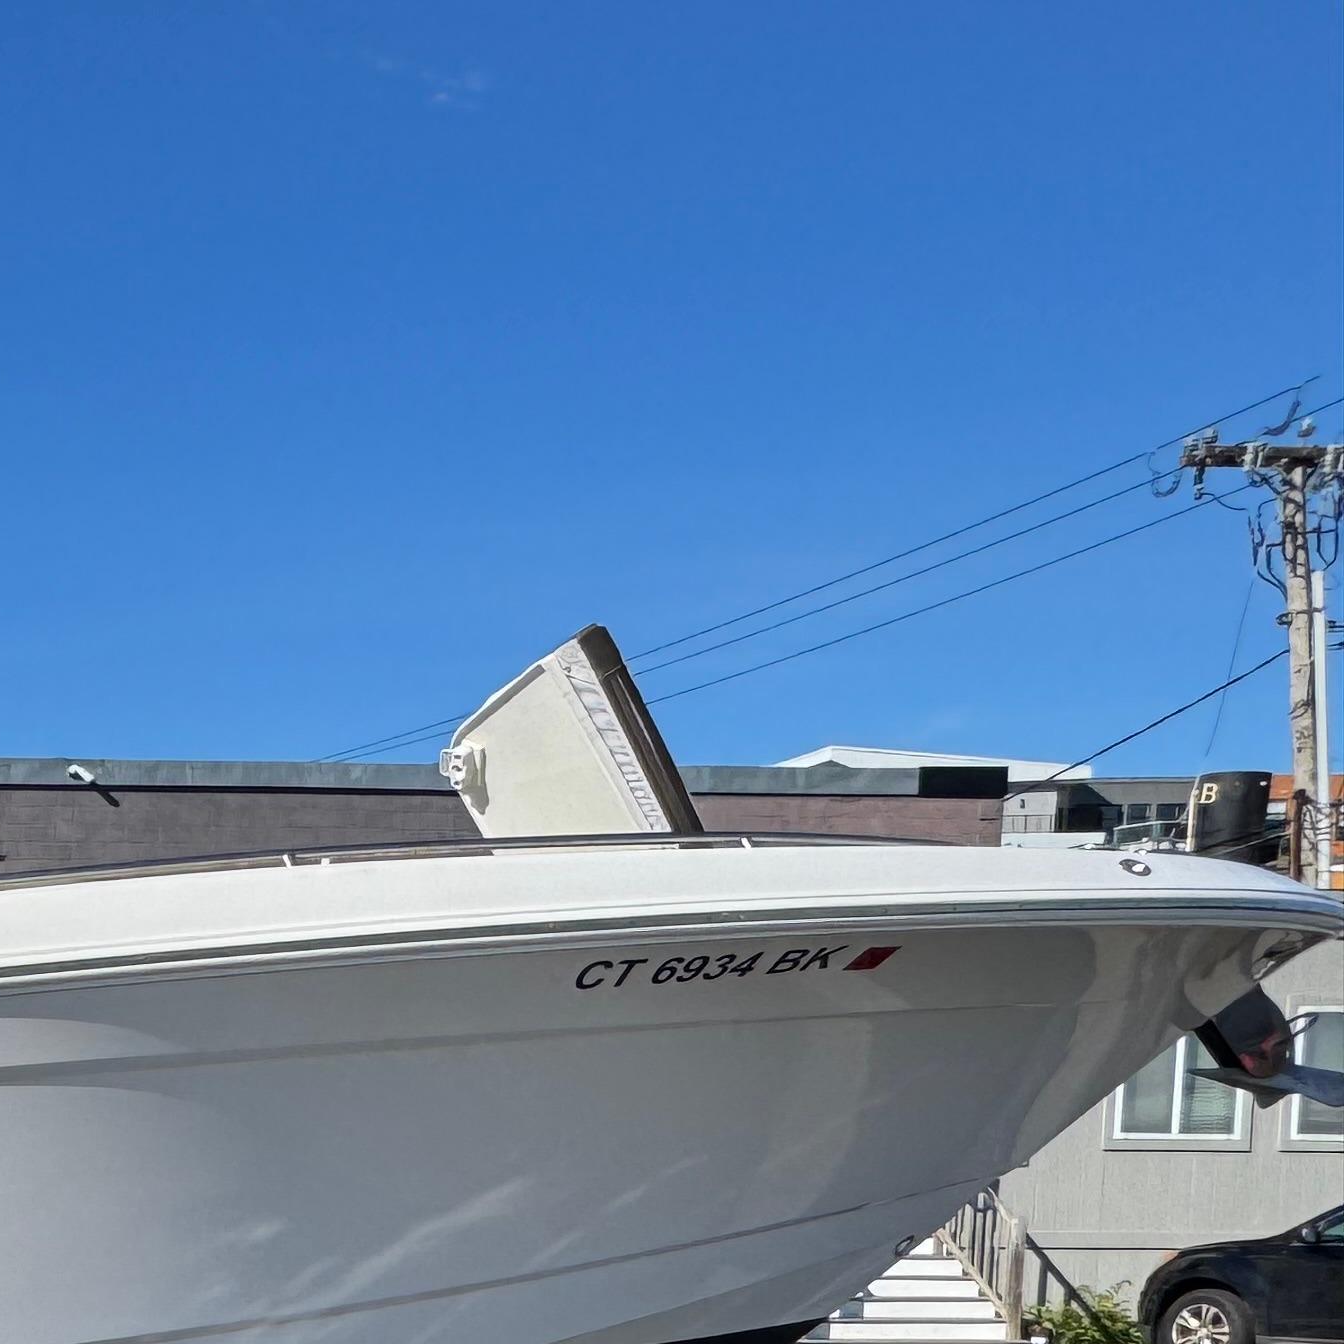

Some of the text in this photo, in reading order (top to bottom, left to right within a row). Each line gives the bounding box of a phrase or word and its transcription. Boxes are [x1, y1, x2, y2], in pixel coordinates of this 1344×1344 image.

[1198, 782, 1219, 804] B
[575, 945, 851, 990] CT 6934 BK
